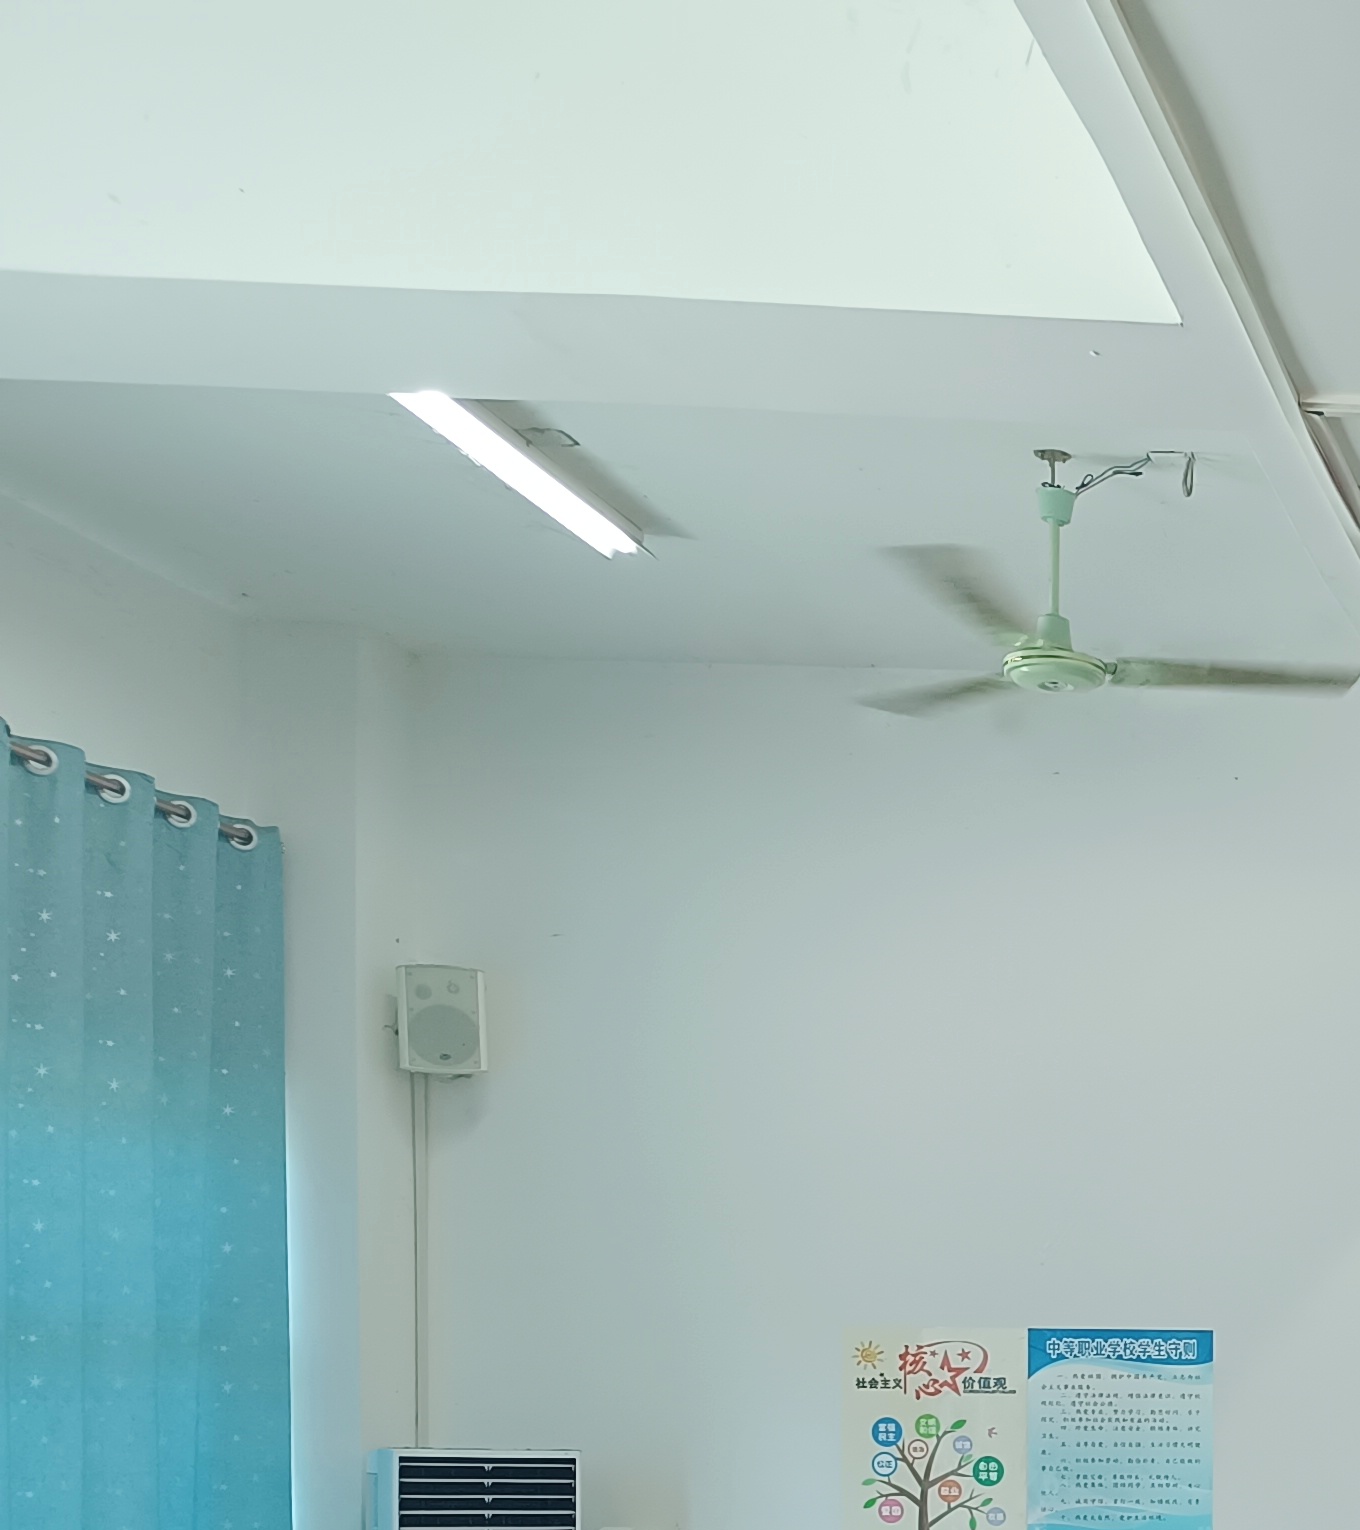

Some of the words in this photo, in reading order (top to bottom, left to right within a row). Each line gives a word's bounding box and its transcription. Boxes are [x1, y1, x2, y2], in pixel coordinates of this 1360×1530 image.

[1046, 1337, 1198, 1359] 中等职业学校学生守则
[855, 1373, 903, 1389] 社会主义
[962, 1377, 1007, 1390] 价值观
